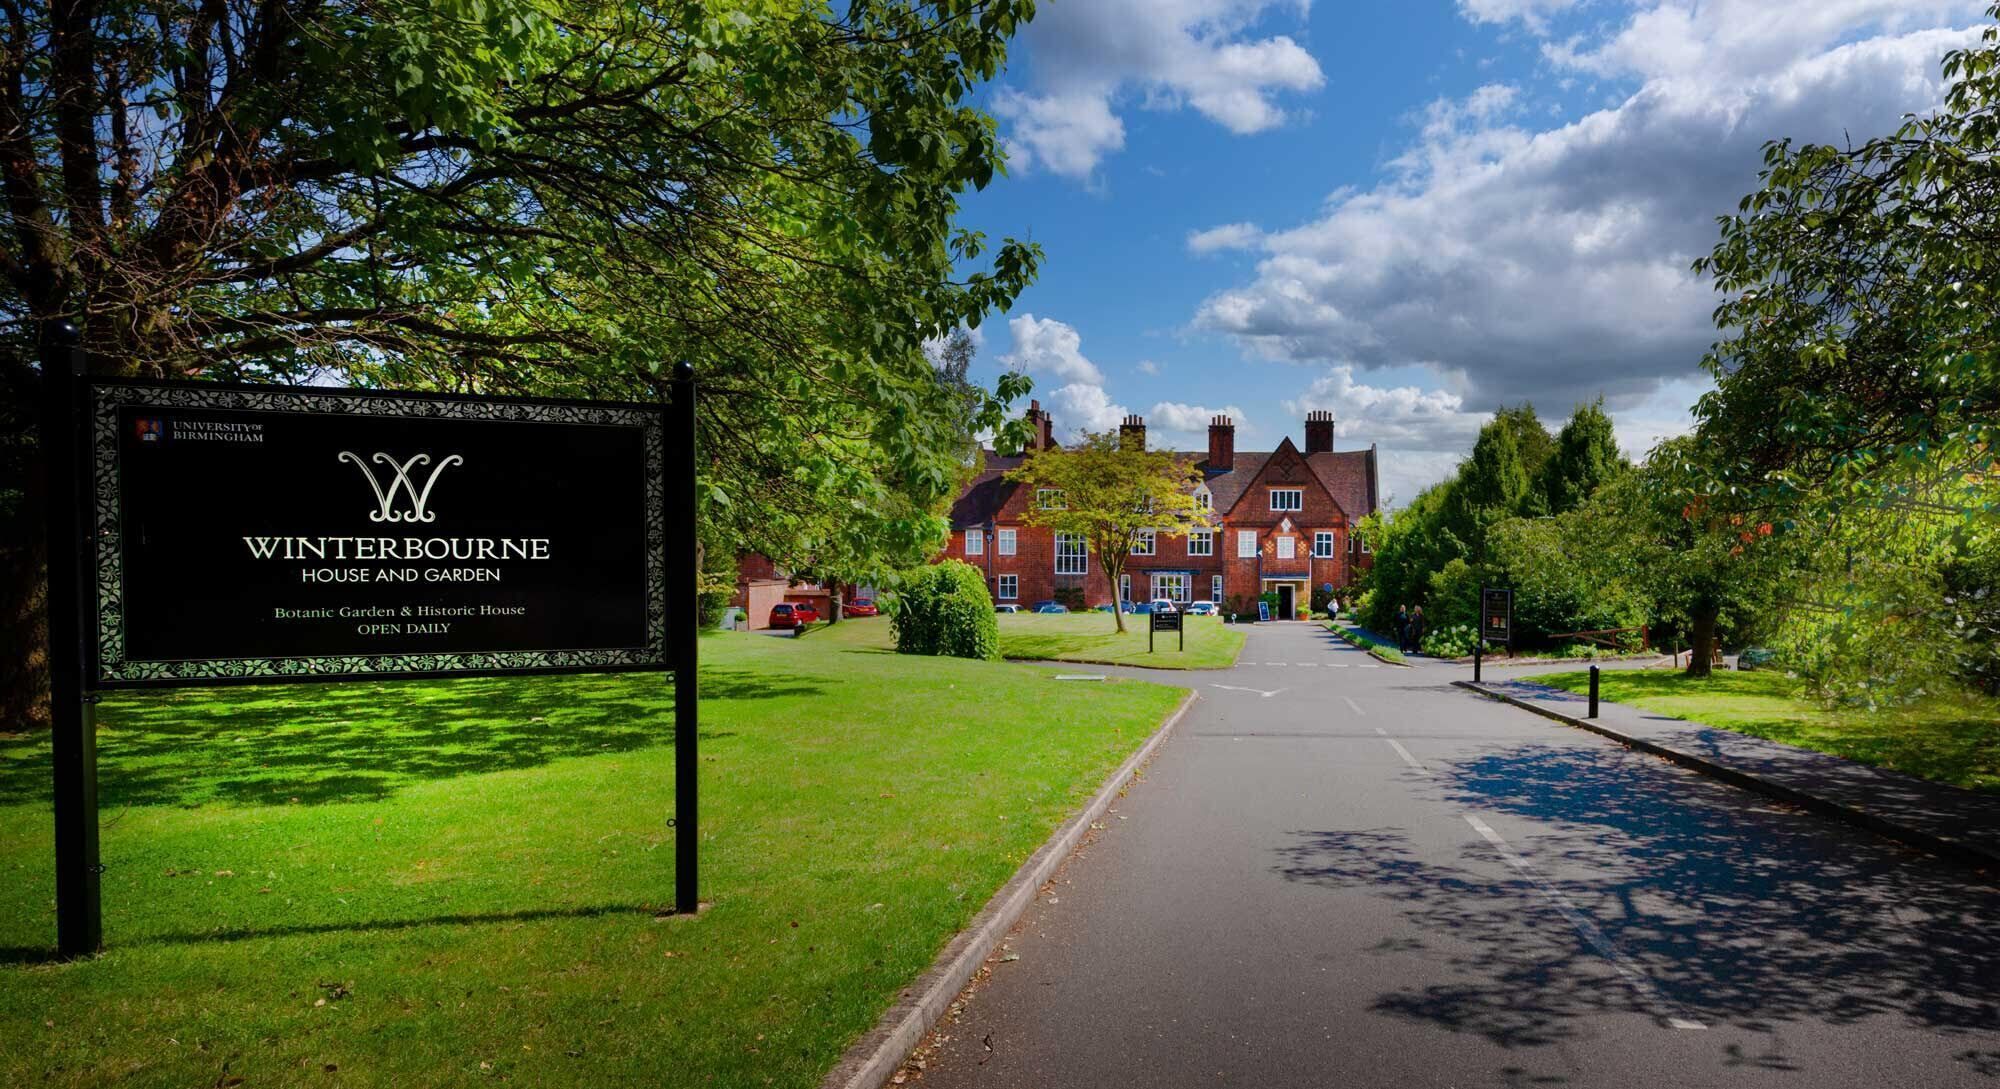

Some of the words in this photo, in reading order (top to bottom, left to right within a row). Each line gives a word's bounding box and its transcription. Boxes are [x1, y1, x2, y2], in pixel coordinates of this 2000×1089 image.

[173, 420, 250, 432] UNIVERSITY
[173, 430, 264, 442] BIRMINGHAM
[242, 536, 551, 560] WINTERBOURNE
[302, 568, 370, 583] HOUSE
[375, 567, 419, 582] AND
[424, 567, 500, 582] GARDEN
[274, 607, 335, 619] Botanic
[339, 605, 396, 618] Garden
[400, 605, 412, 617] &
[417, 605, 476, 616] Historic
[479, 604, 526, 616] House
[357, 623, 401, 635] OPEN
[407, 622, 452, 634] DAILY
